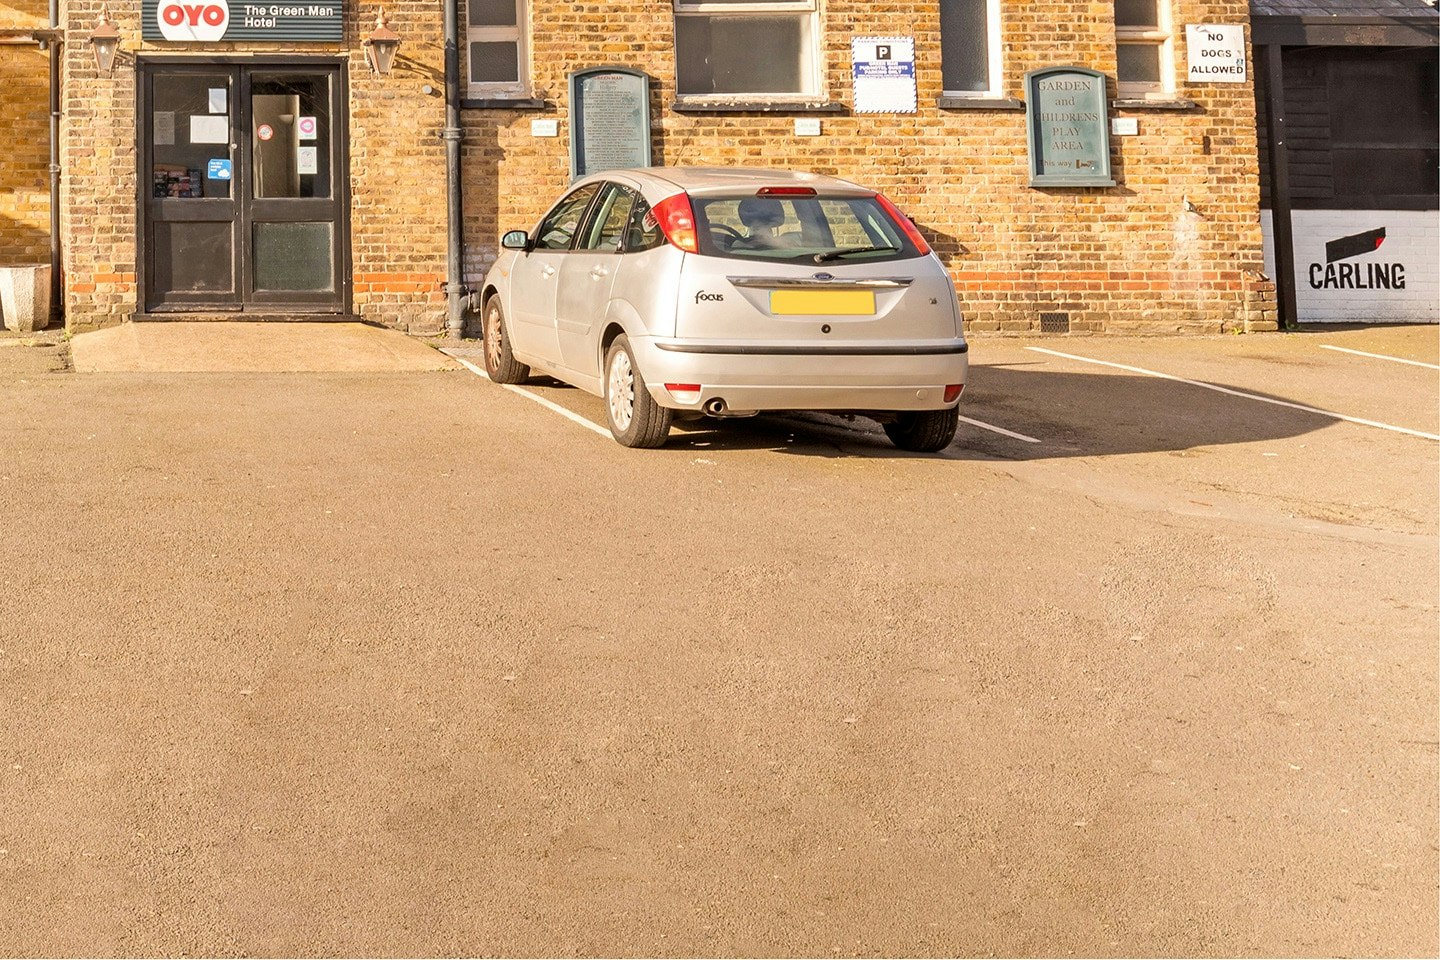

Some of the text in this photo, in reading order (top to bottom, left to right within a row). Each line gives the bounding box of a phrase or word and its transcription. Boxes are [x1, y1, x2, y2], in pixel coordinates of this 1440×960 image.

[162, 4, 225, 27] OYO
[244, 5, 334, 16] The Green Man
[244, 17, 276, 28] Hotel
[1208, 33, 1224, 41] NO
[879, 47, 888, 58] P
[1201, 49, 1232, 57] DOGS
[1191, 66, 1244, 74] ALLOWED
[1038, 81, 1091, 91] GARDEN
[1055, 96, 1075, 106] and
[1052, 127, 1081, 136] PLAY
[1052, 141, 1083, 150] AREA
[1309, 263, 1405, 290] CARLING
